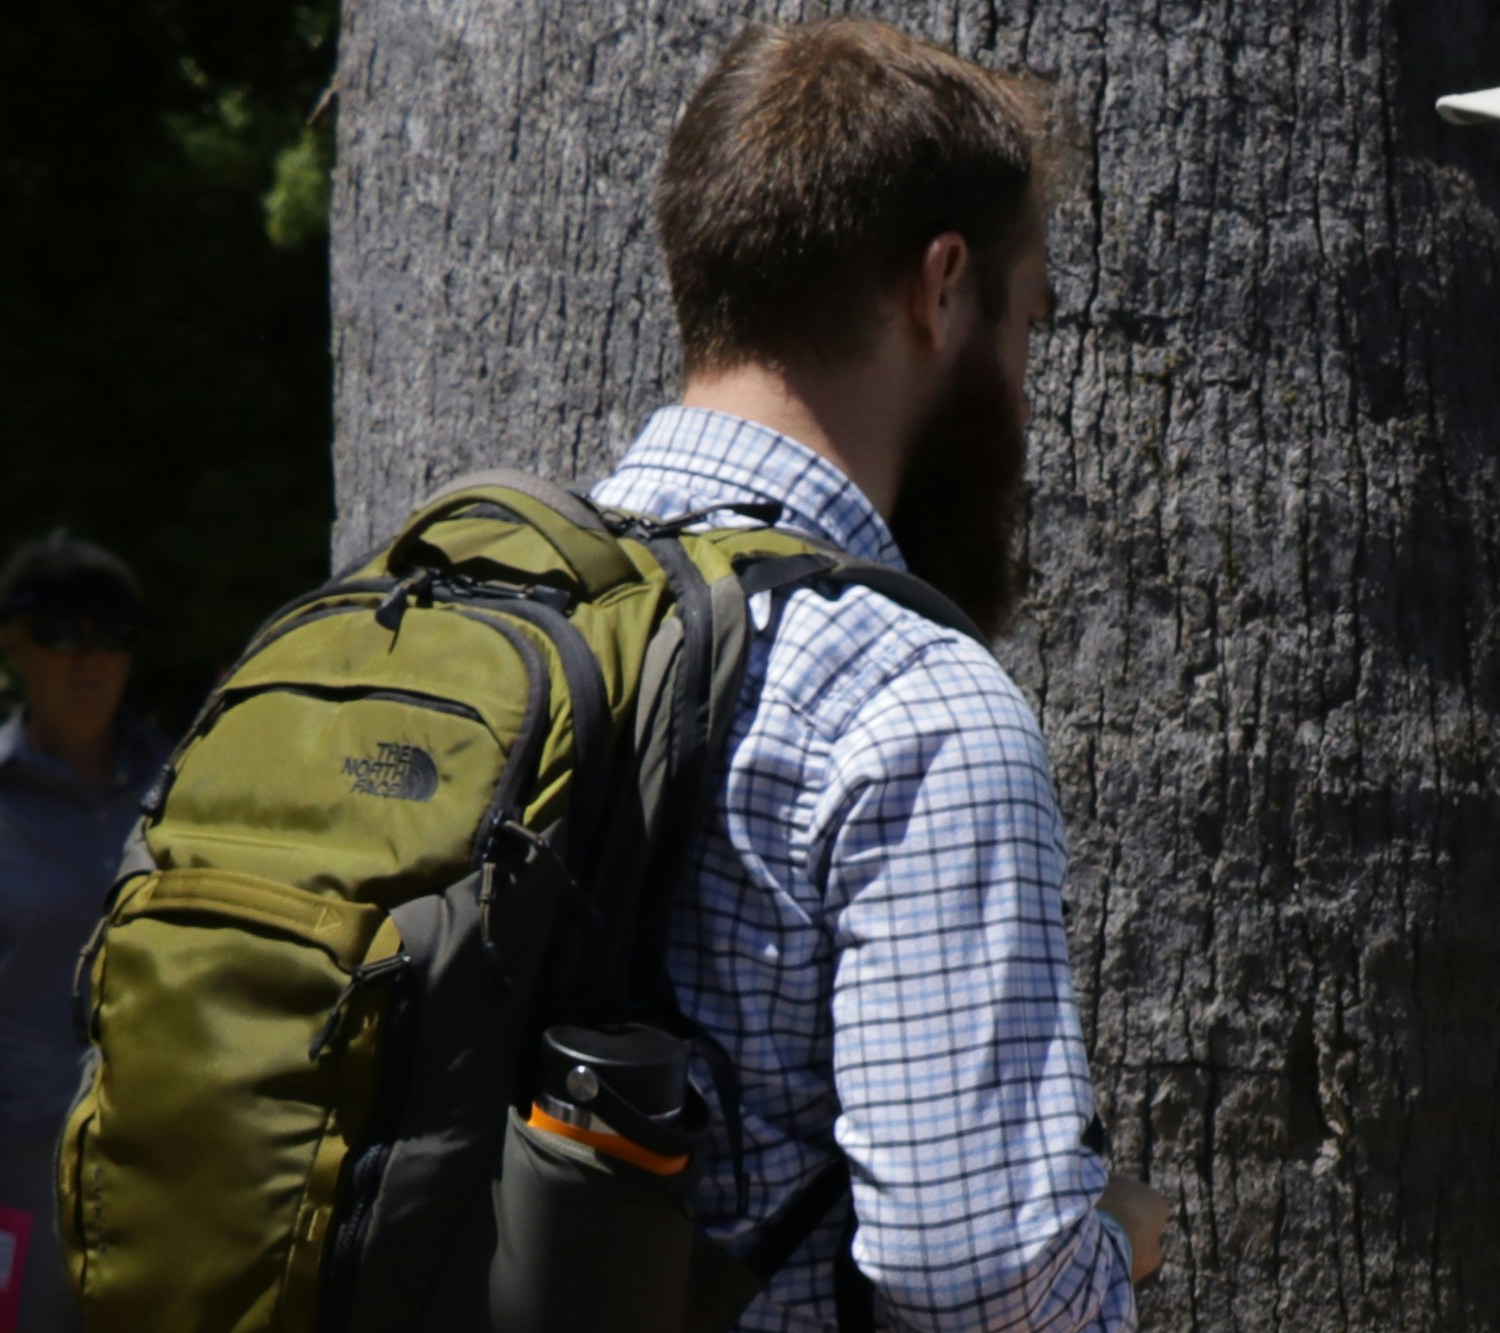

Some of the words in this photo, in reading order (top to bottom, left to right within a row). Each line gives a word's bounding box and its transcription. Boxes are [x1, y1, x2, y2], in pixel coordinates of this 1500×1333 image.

[376, 742, 412, 764] THE
[341, 757, 410, 780] NORTH
[351, 778, 403, 799] FACE
